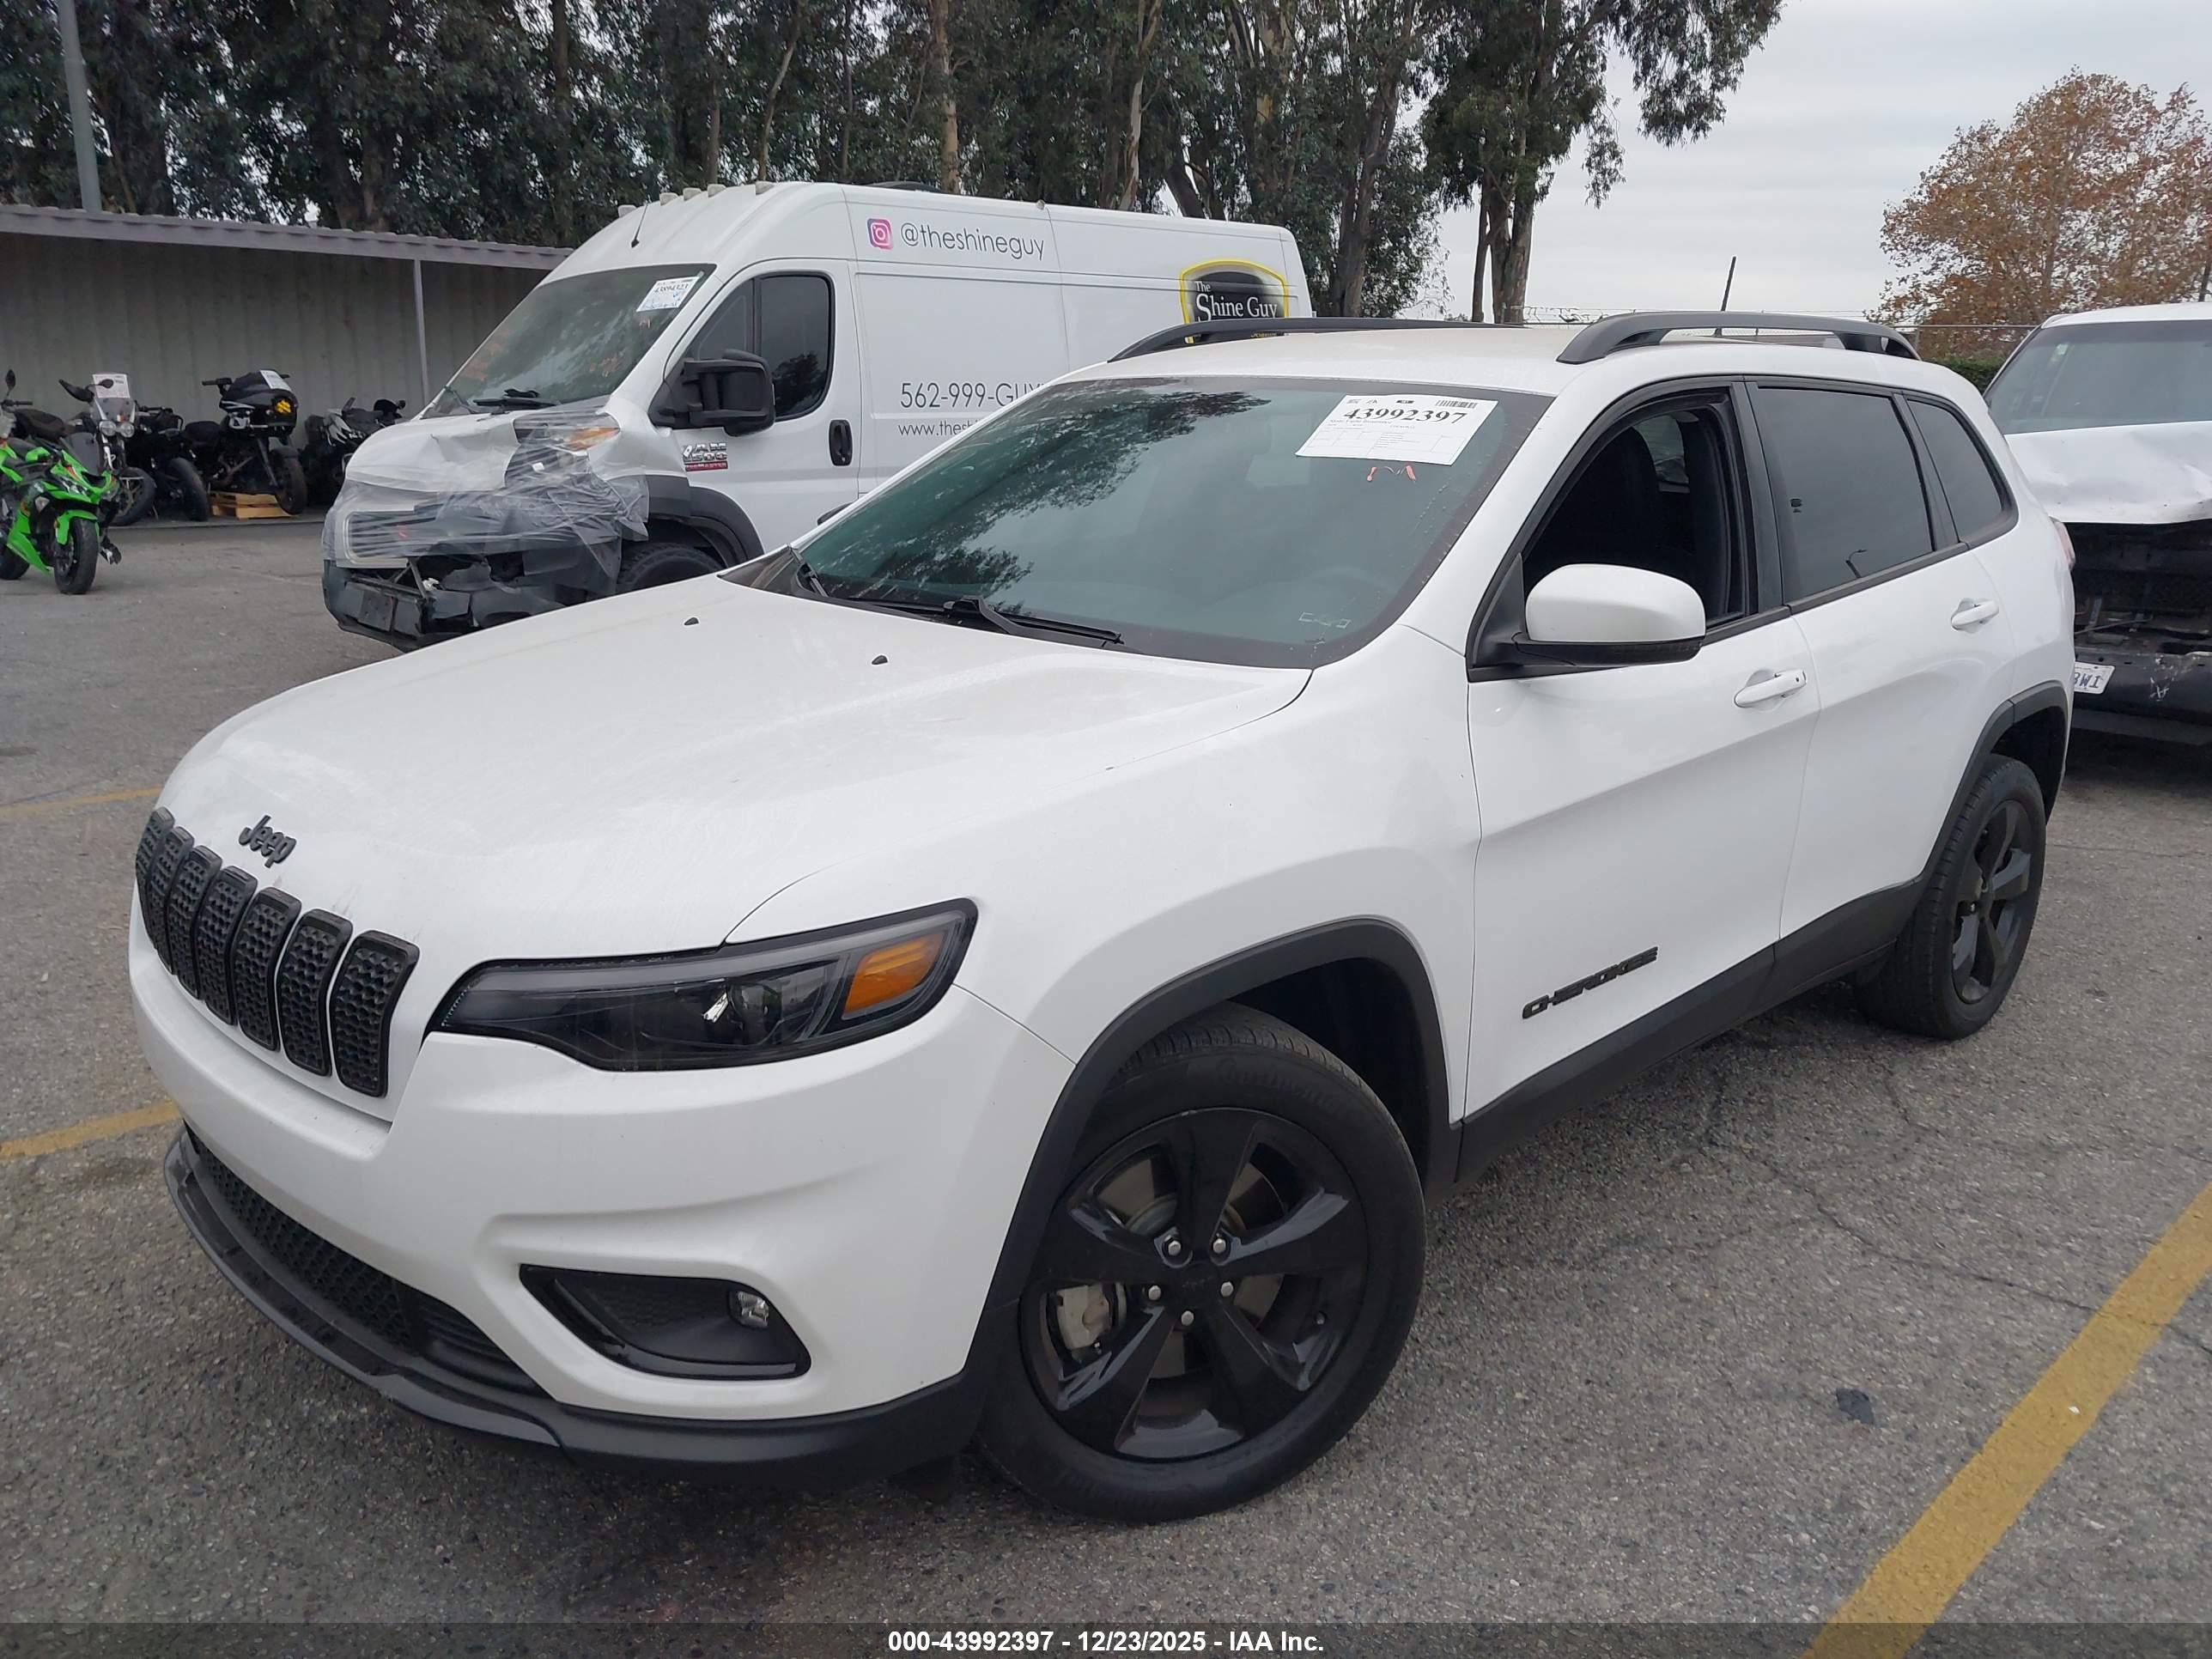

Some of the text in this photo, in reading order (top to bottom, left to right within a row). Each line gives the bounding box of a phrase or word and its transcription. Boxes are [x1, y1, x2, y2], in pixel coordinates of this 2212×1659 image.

[900, 222, 1044, 261] @theshineguy
[1194, 281, 1212, 292] The
[1196, 293, 1278, 323] Shine Guy
[1343, 407, 1468, 424] 43992397
[239, 815, 297, 869] Jeep
[1522, 946, 1658, 1019] CHEROKEE
